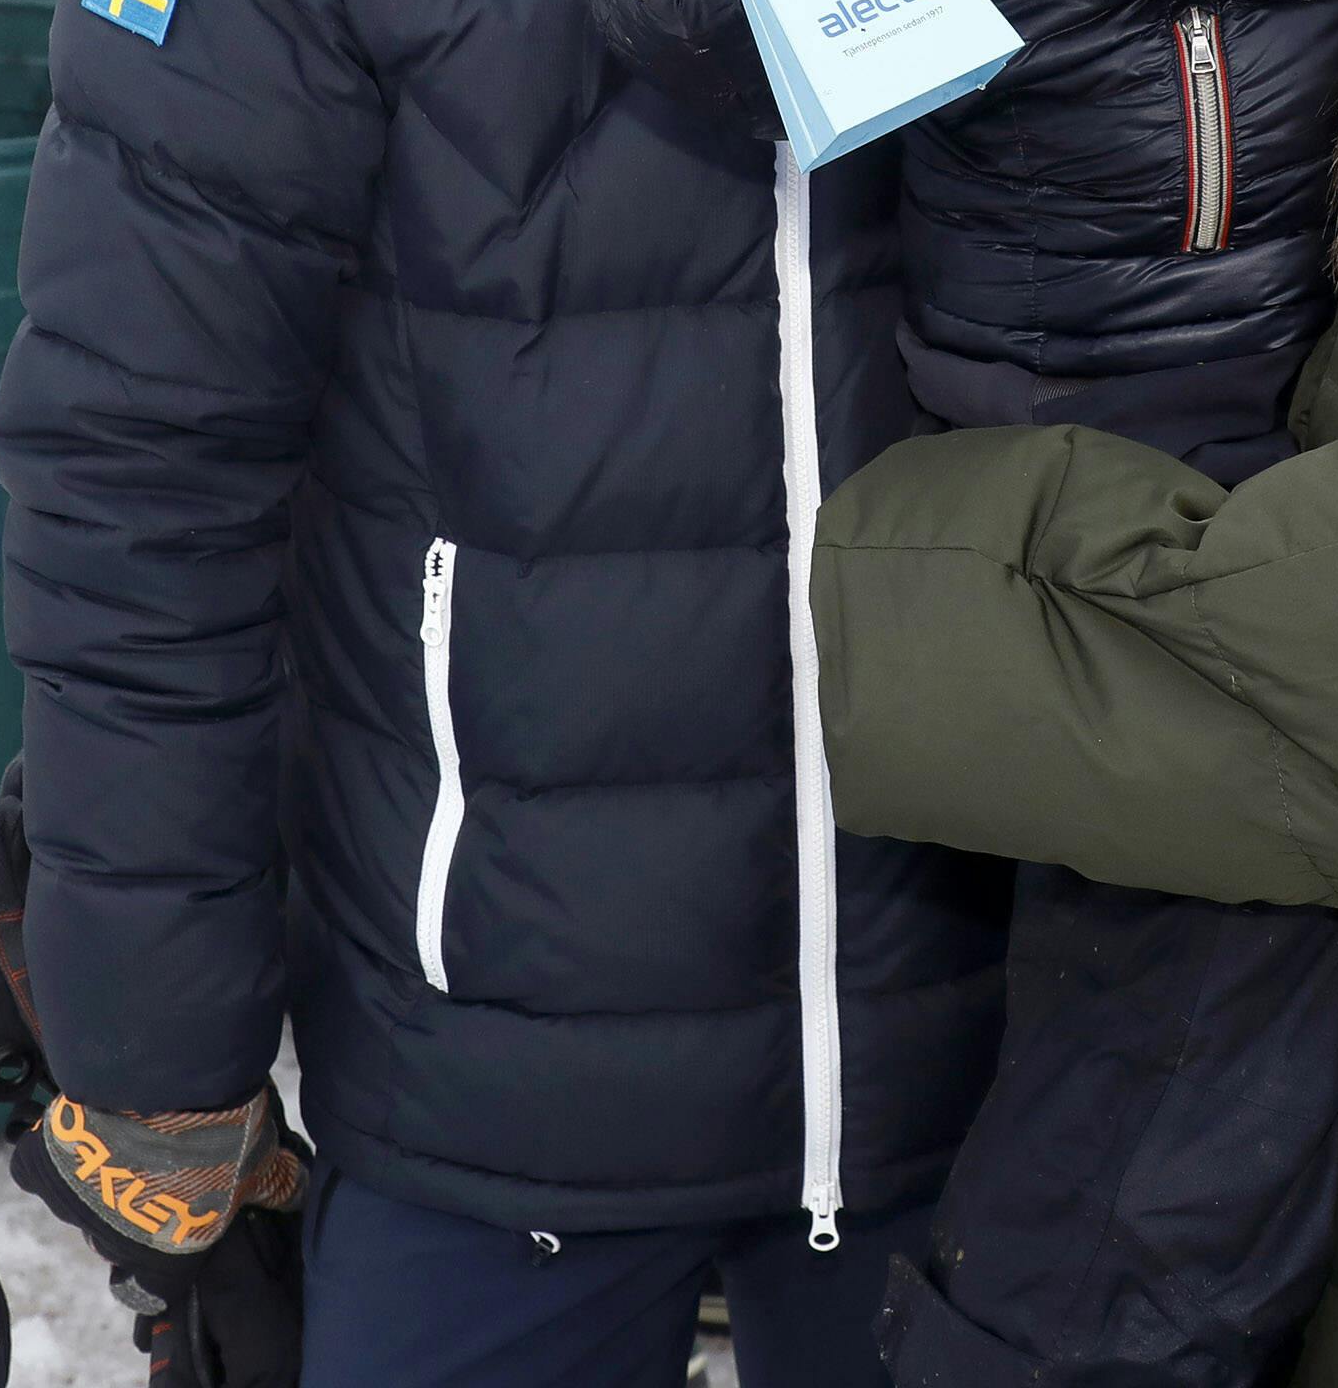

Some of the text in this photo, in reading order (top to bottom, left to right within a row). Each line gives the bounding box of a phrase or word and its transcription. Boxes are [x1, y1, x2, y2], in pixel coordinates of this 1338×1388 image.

[842, 5, 944, 58] Tjänstepension sedan 1917
[50, 1094, 219, 1245] OAKLEY
